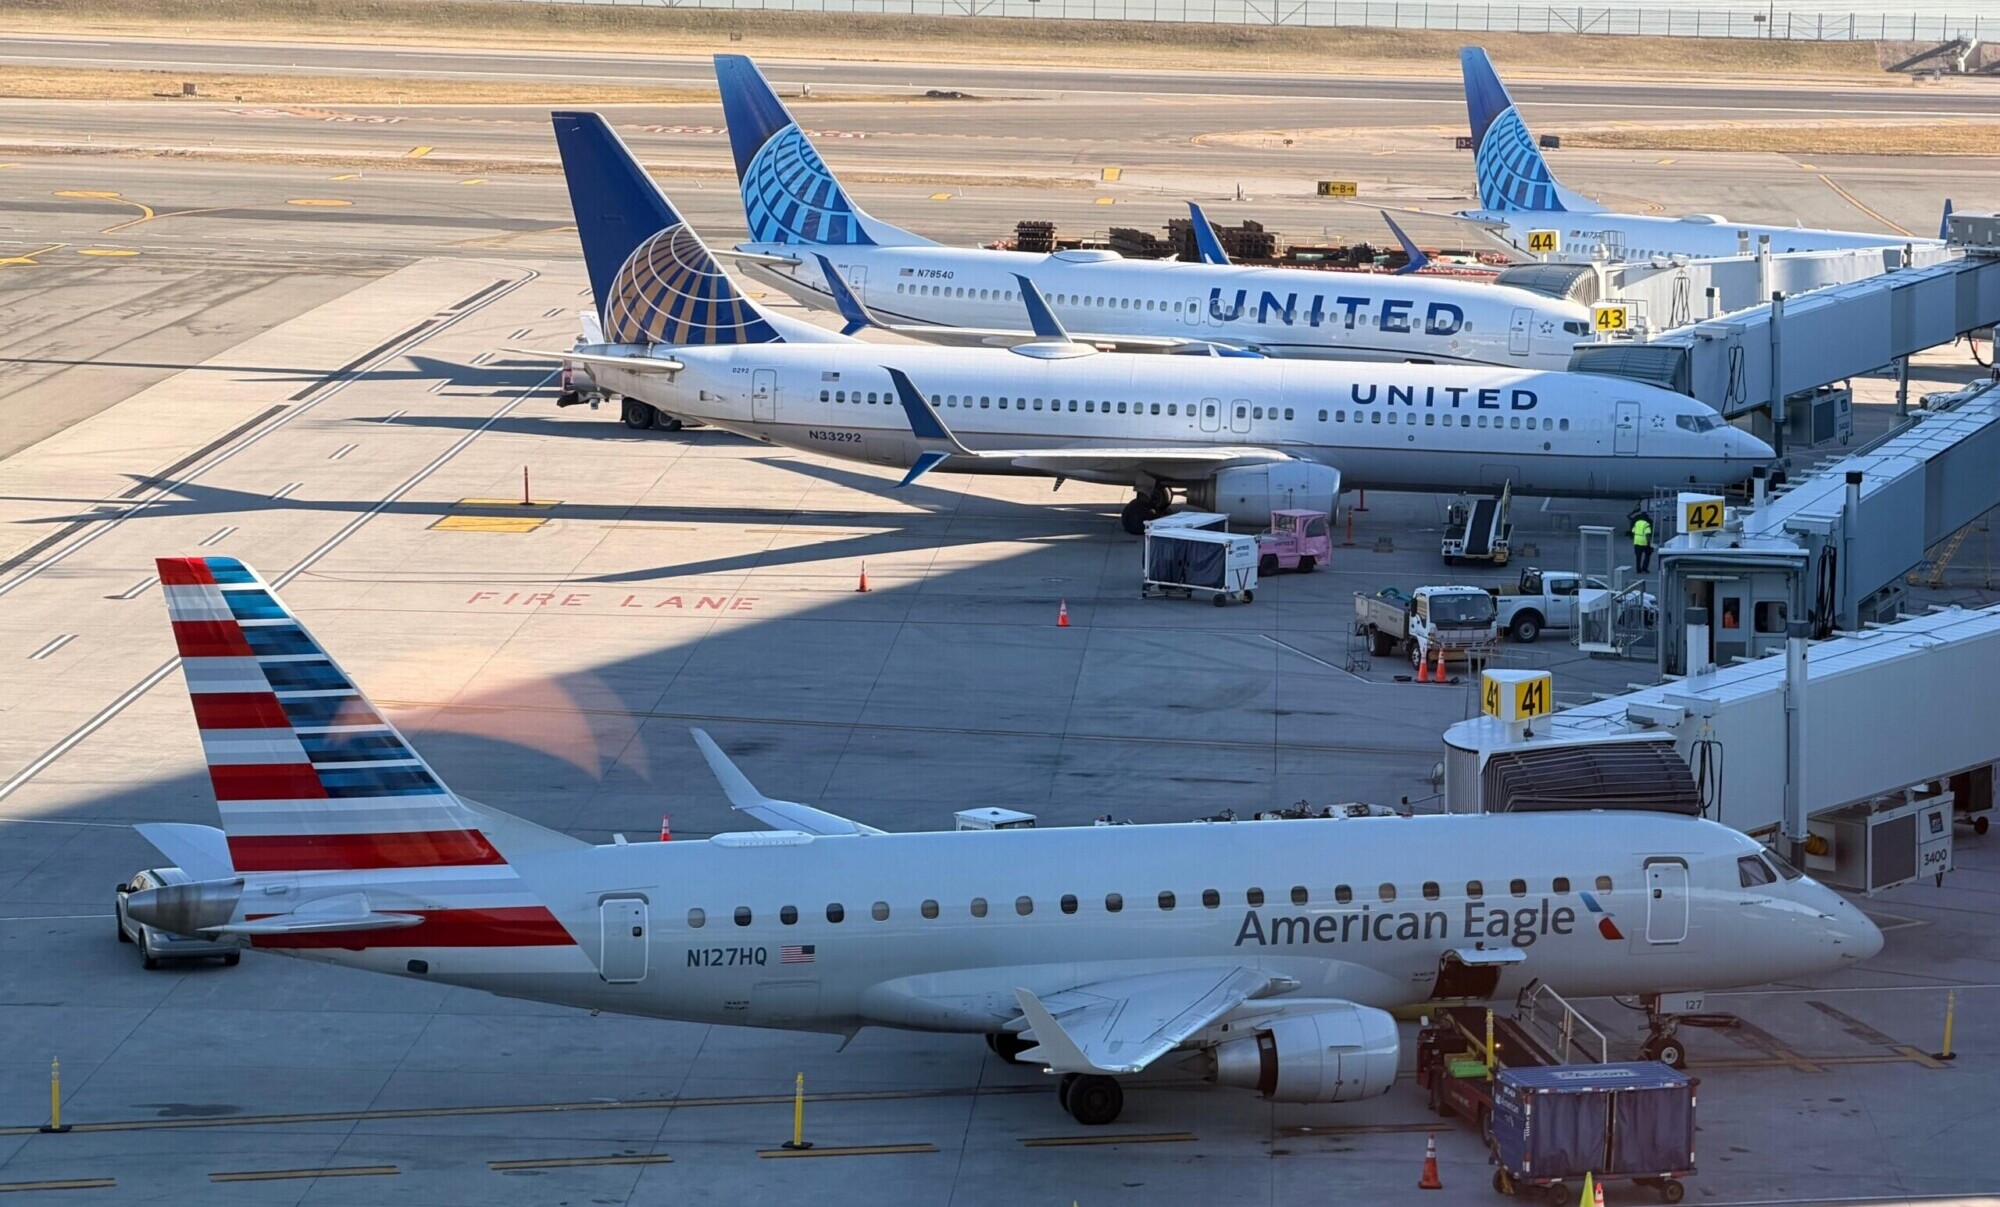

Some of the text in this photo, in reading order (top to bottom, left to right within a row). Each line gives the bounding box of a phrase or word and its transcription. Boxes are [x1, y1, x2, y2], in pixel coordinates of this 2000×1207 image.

[1320, 184, 1346, 193] K B
[1530, 233, 1554, 251] 44
[917, 269, 954, 279] N78540
[1209, 288, 1464, 336] UNITED
[1598, 309, 1623, 328] 43
[1351, 384, 1538, 410] UNITED
[809, 430, 861, 442] N33292
[1690, 504, 1719, 529] 42
[467, 592, 760, 610] FIRE LANE
[1487, 680, 1498, 717] 41
[1522, 680, 1543, 716] 41
[1924, 849, 1947, 866] 3400
[1234, 898, 1576, 948] American Eagle
[687, 947, 767, 967] N127HQ
[1685, 1000, 1702, 1010] 127
